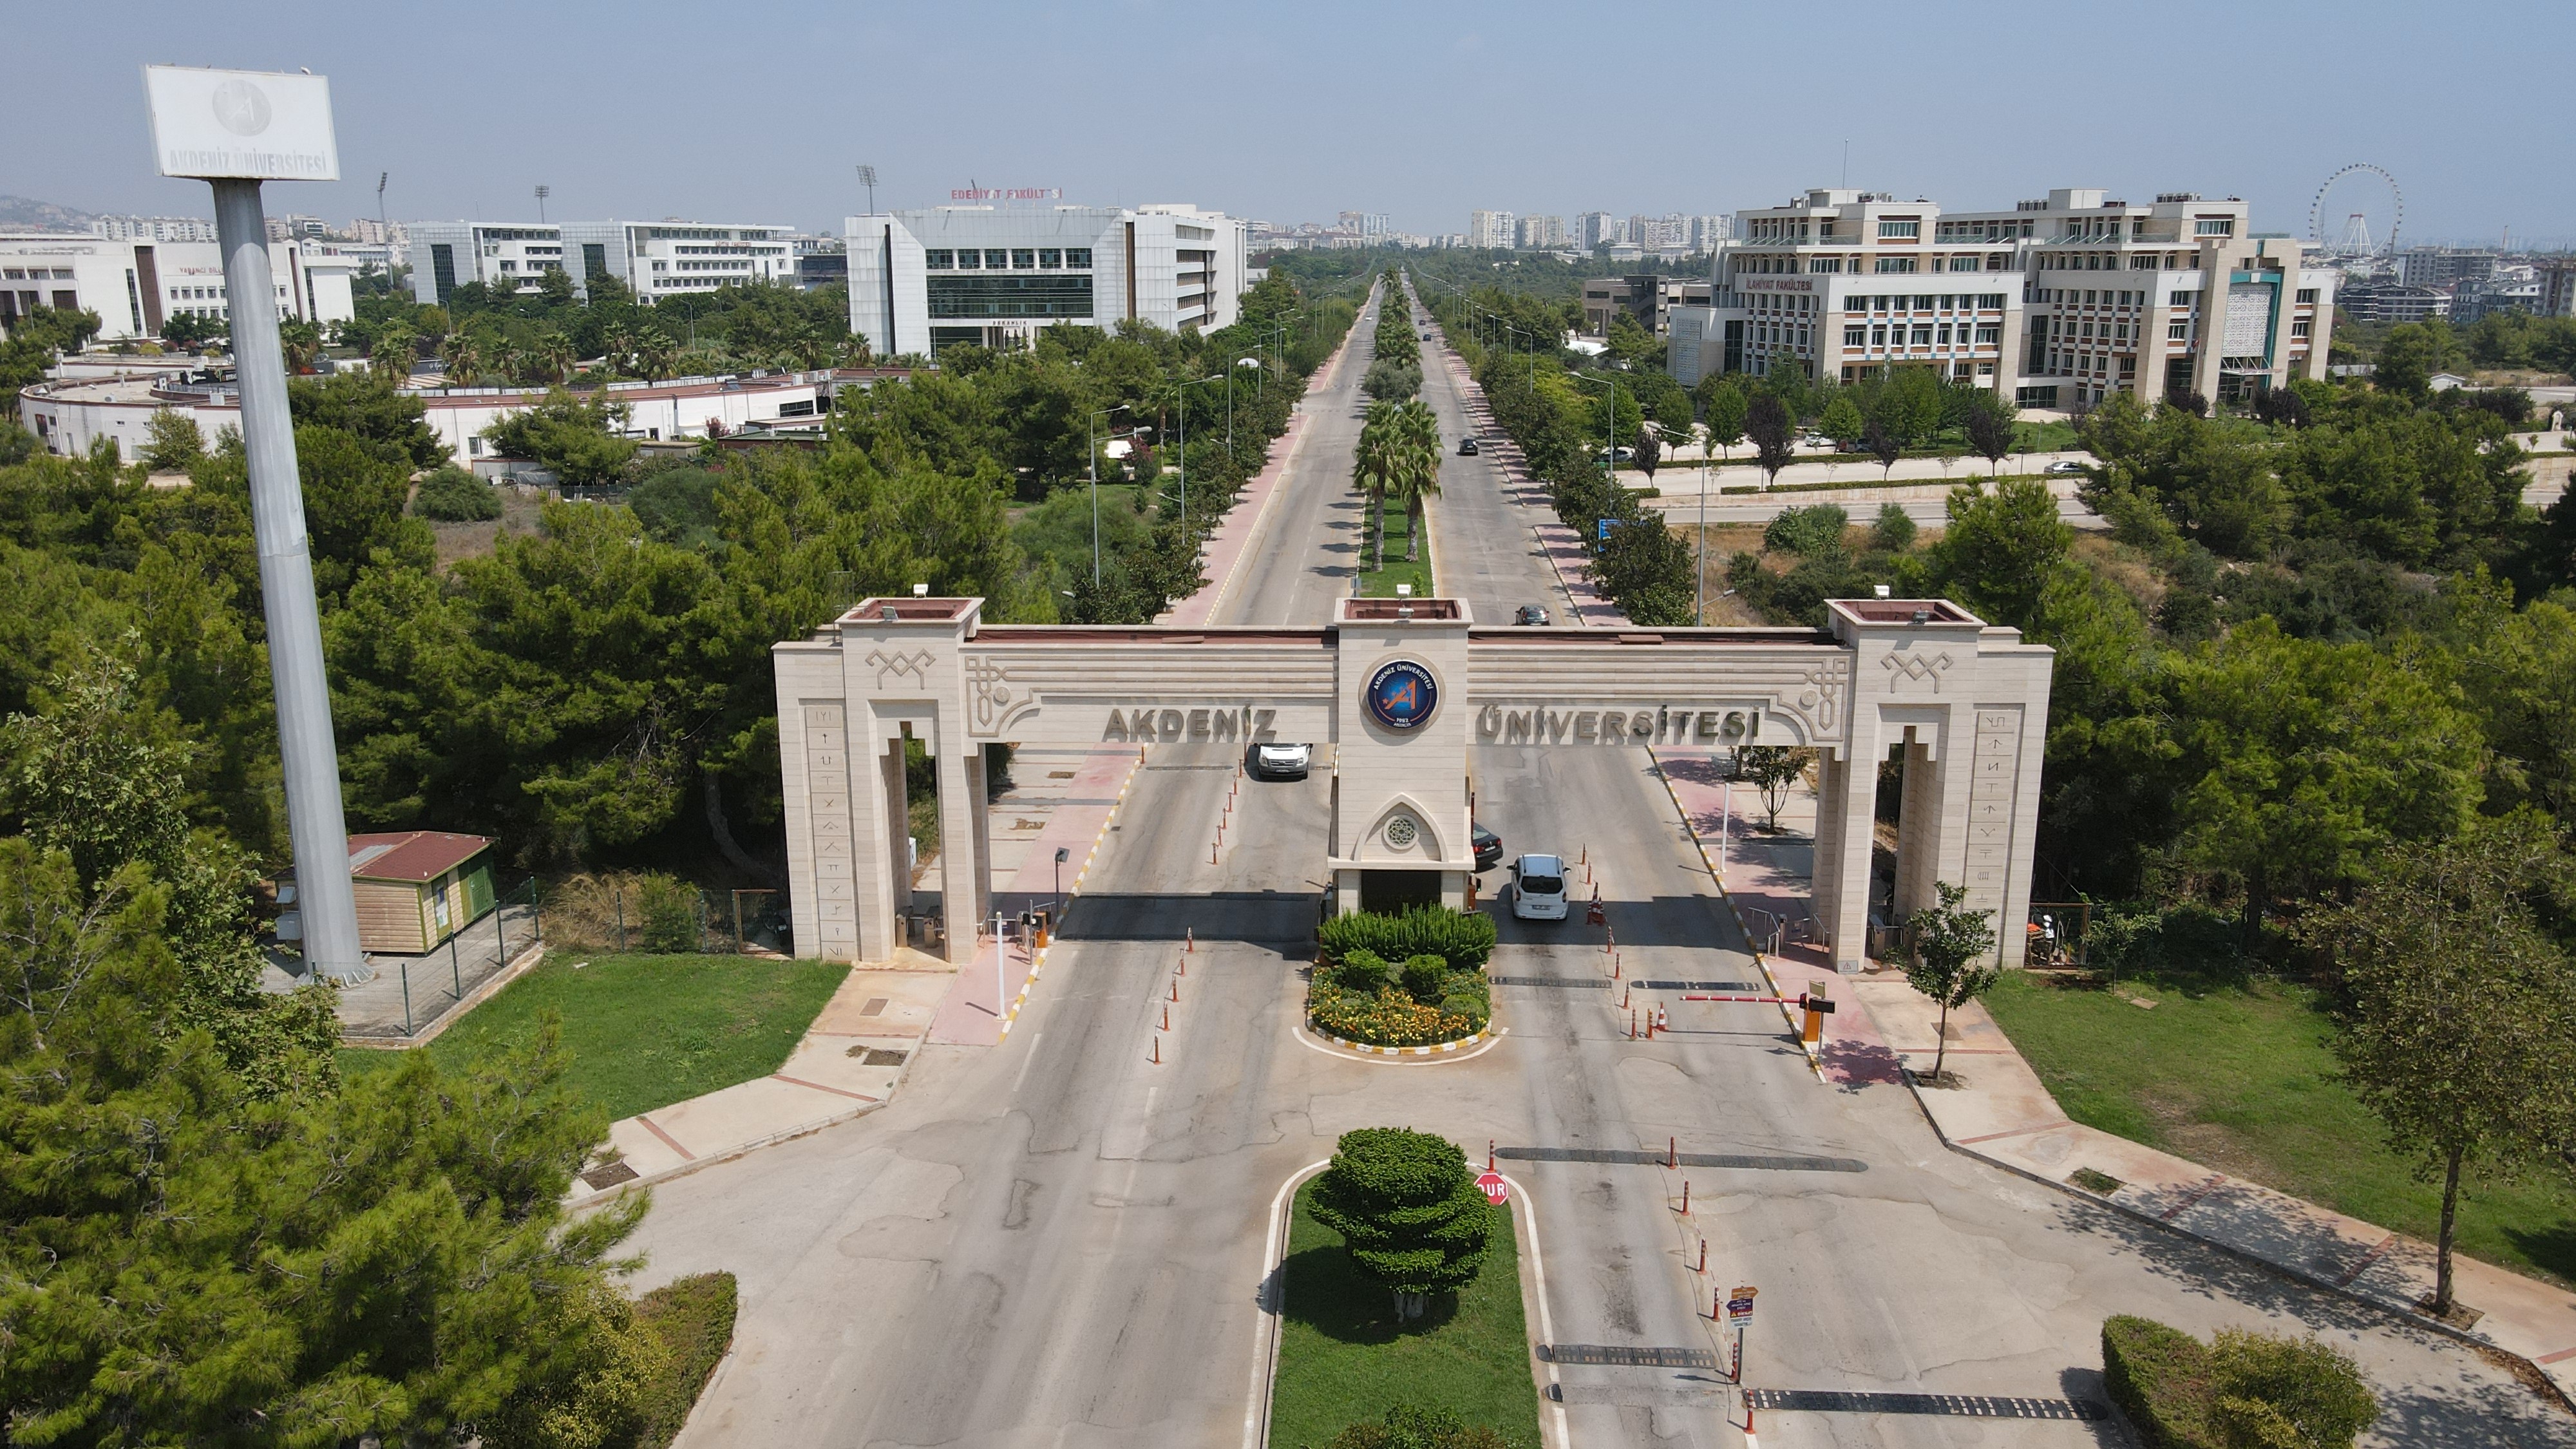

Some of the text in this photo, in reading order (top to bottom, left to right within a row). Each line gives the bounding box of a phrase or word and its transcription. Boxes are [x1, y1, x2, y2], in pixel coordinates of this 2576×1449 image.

[951, 187, 1062, 199] EDEBİYAT FAKÜLTSİ
[1746, 278, 1812, 290] İLAHİYAT FAKÜLTESİ
[1374, 664, 1434, 690] AKDENİZ ÜNİVERSİTESİ
[1105, 703, 1760, 737] AKDENİZ ÜNİVERSİTESİ
